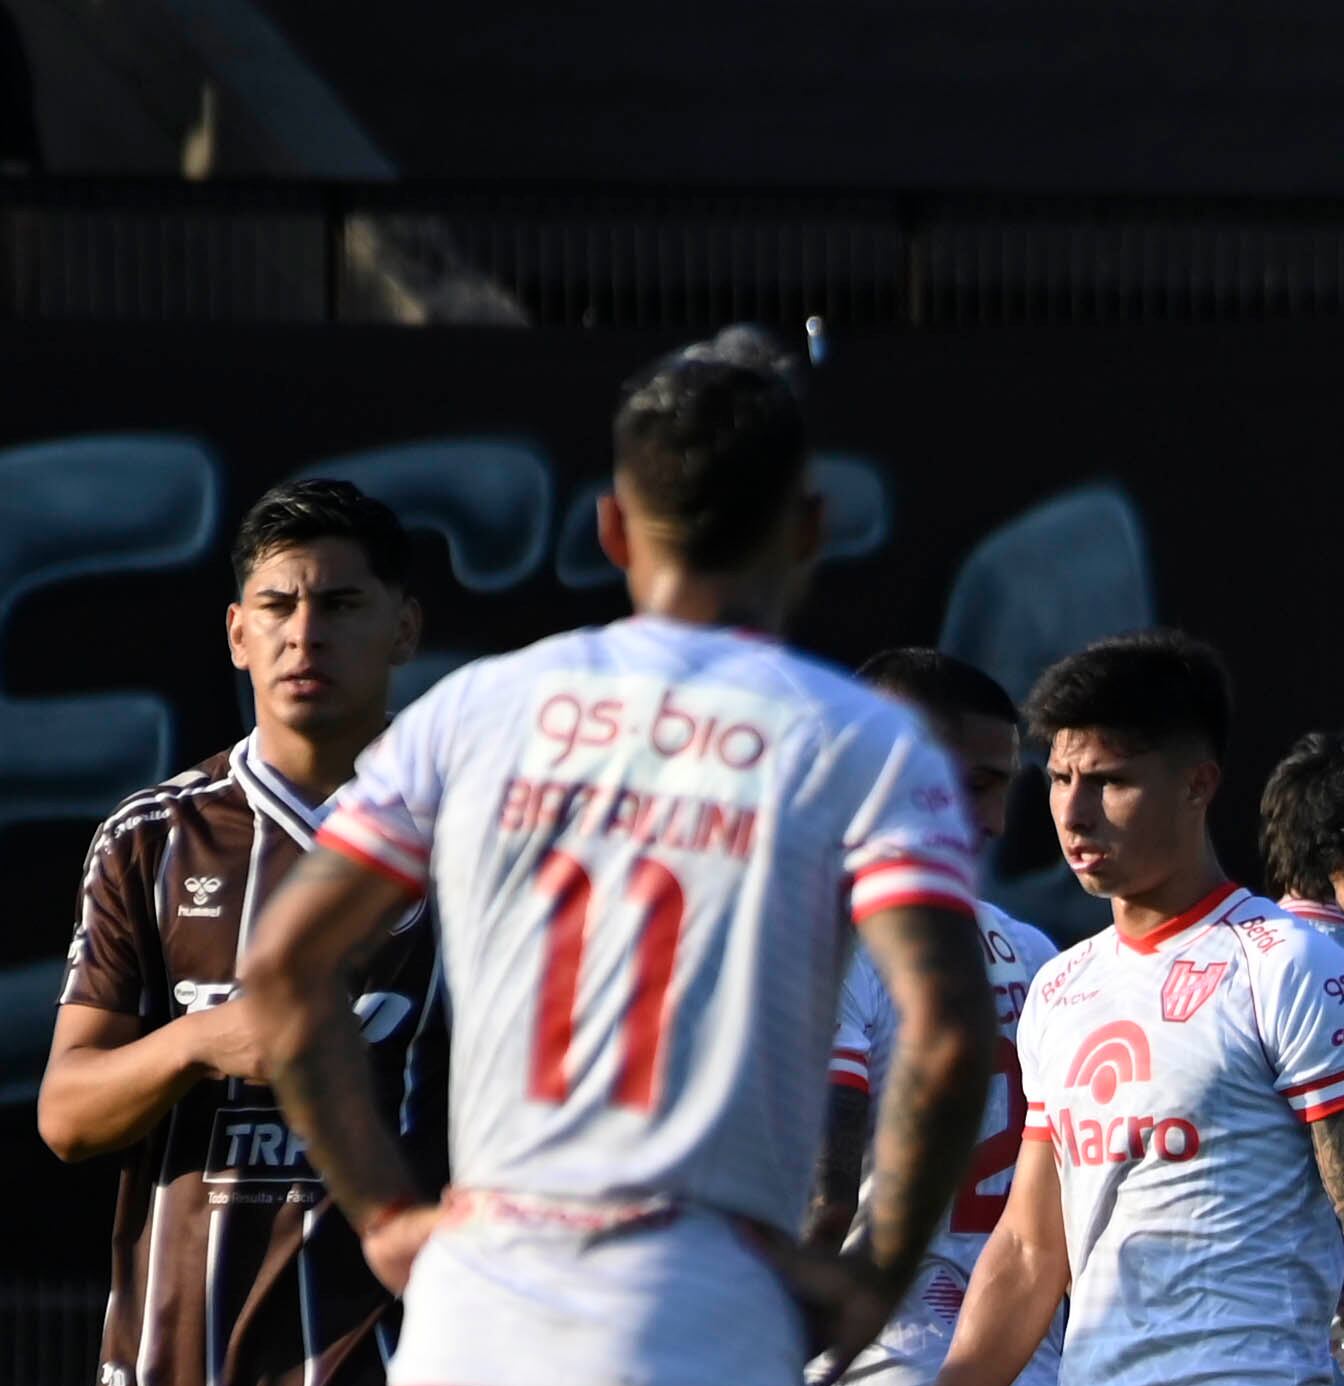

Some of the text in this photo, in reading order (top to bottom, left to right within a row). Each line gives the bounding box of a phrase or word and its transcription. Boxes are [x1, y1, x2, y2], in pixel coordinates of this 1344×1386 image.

[177, 905, 222, 917] hummel
[528, 849, 689, 1113] 11
[1046, 1108, 1200, 1168] Macro
